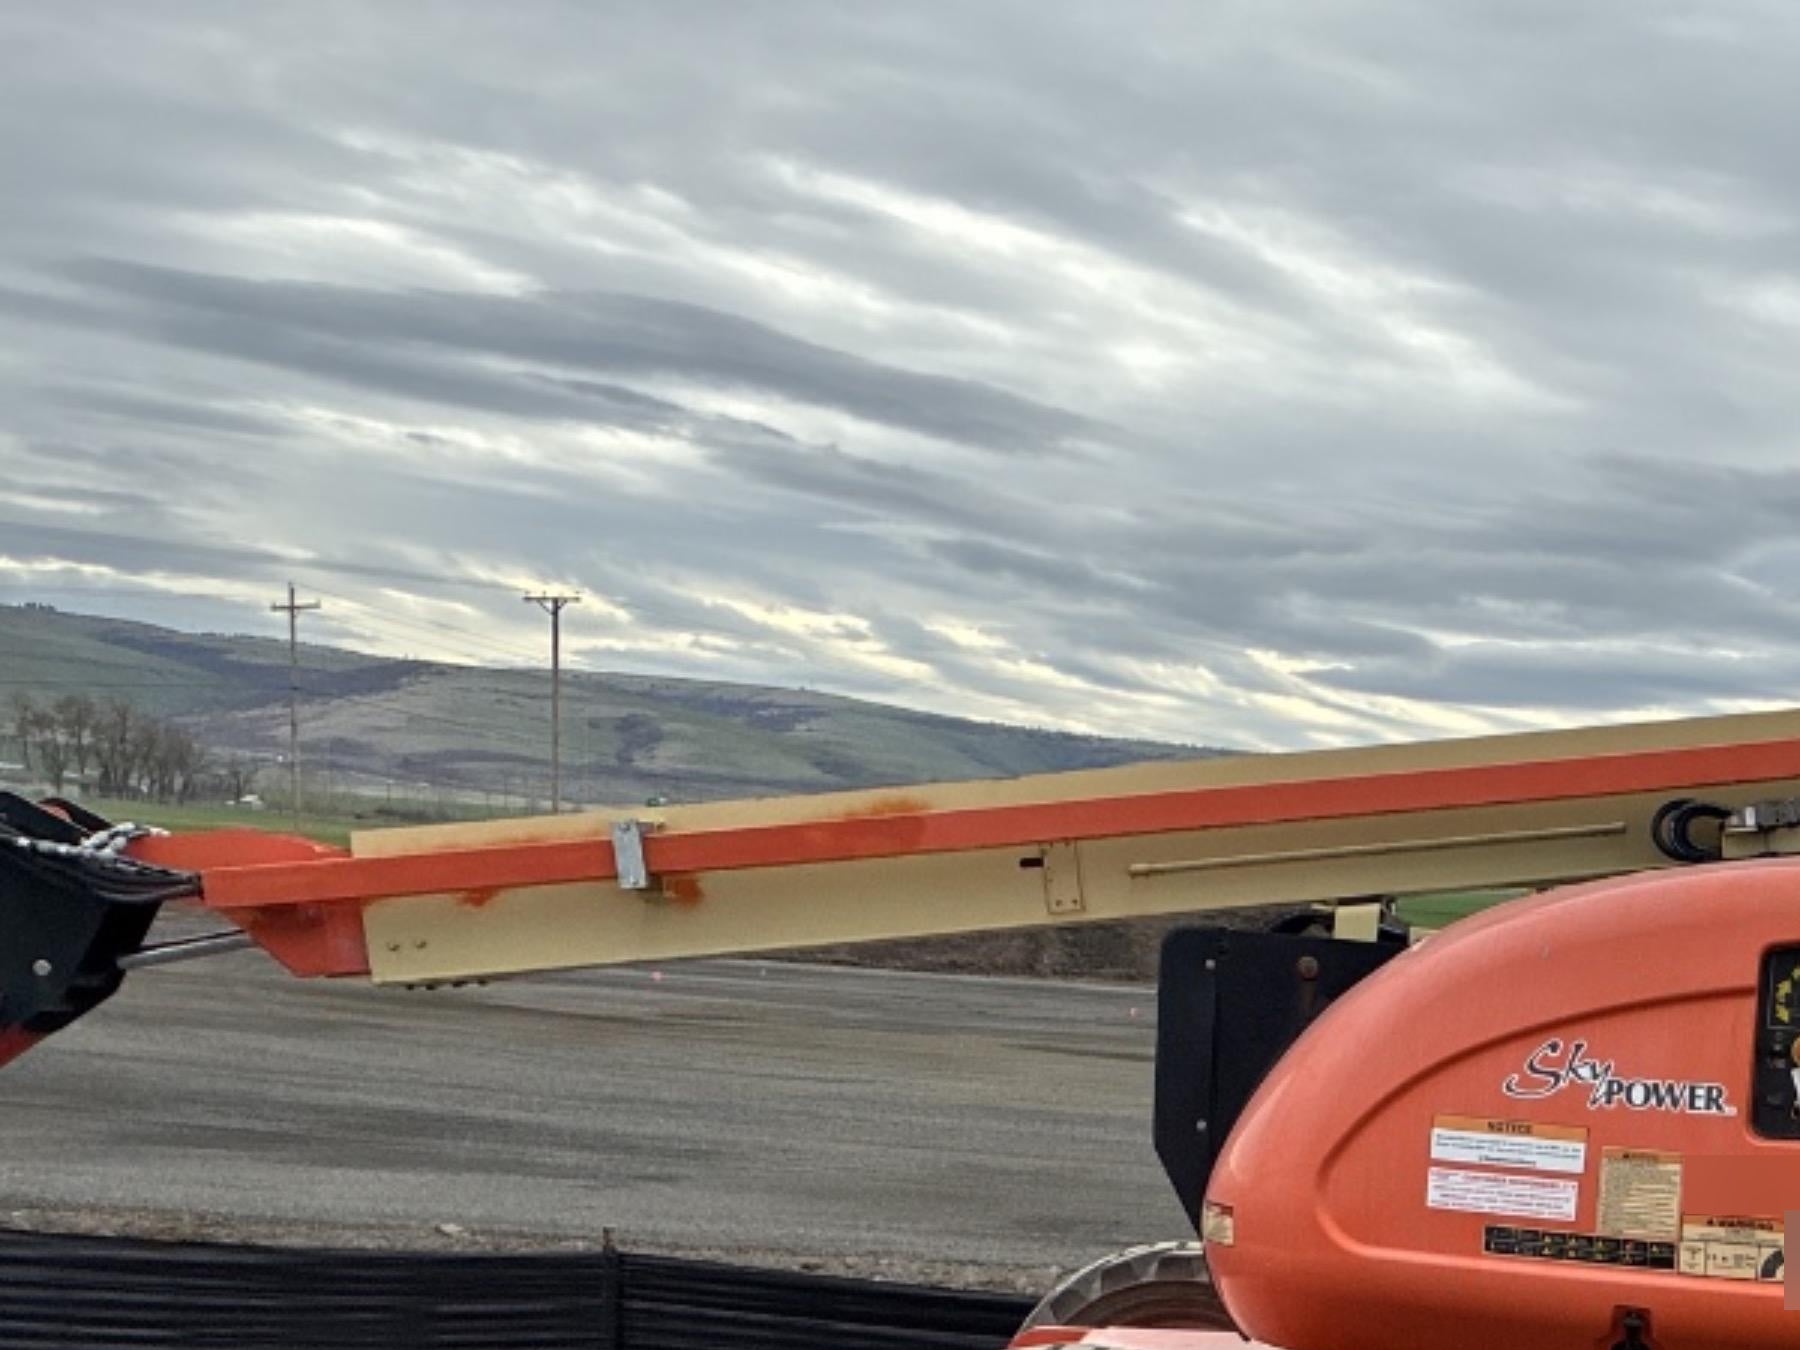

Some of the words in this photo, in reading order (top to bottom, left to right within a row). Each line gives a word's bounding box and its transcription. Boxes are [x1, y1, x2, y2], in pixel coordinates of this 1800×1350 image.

[1503, 1039, 1613, 1108] Sky
[1600, 1078, 1728, 1113] POWER
[1487, 1121, 1533, 1135] NOTICE
